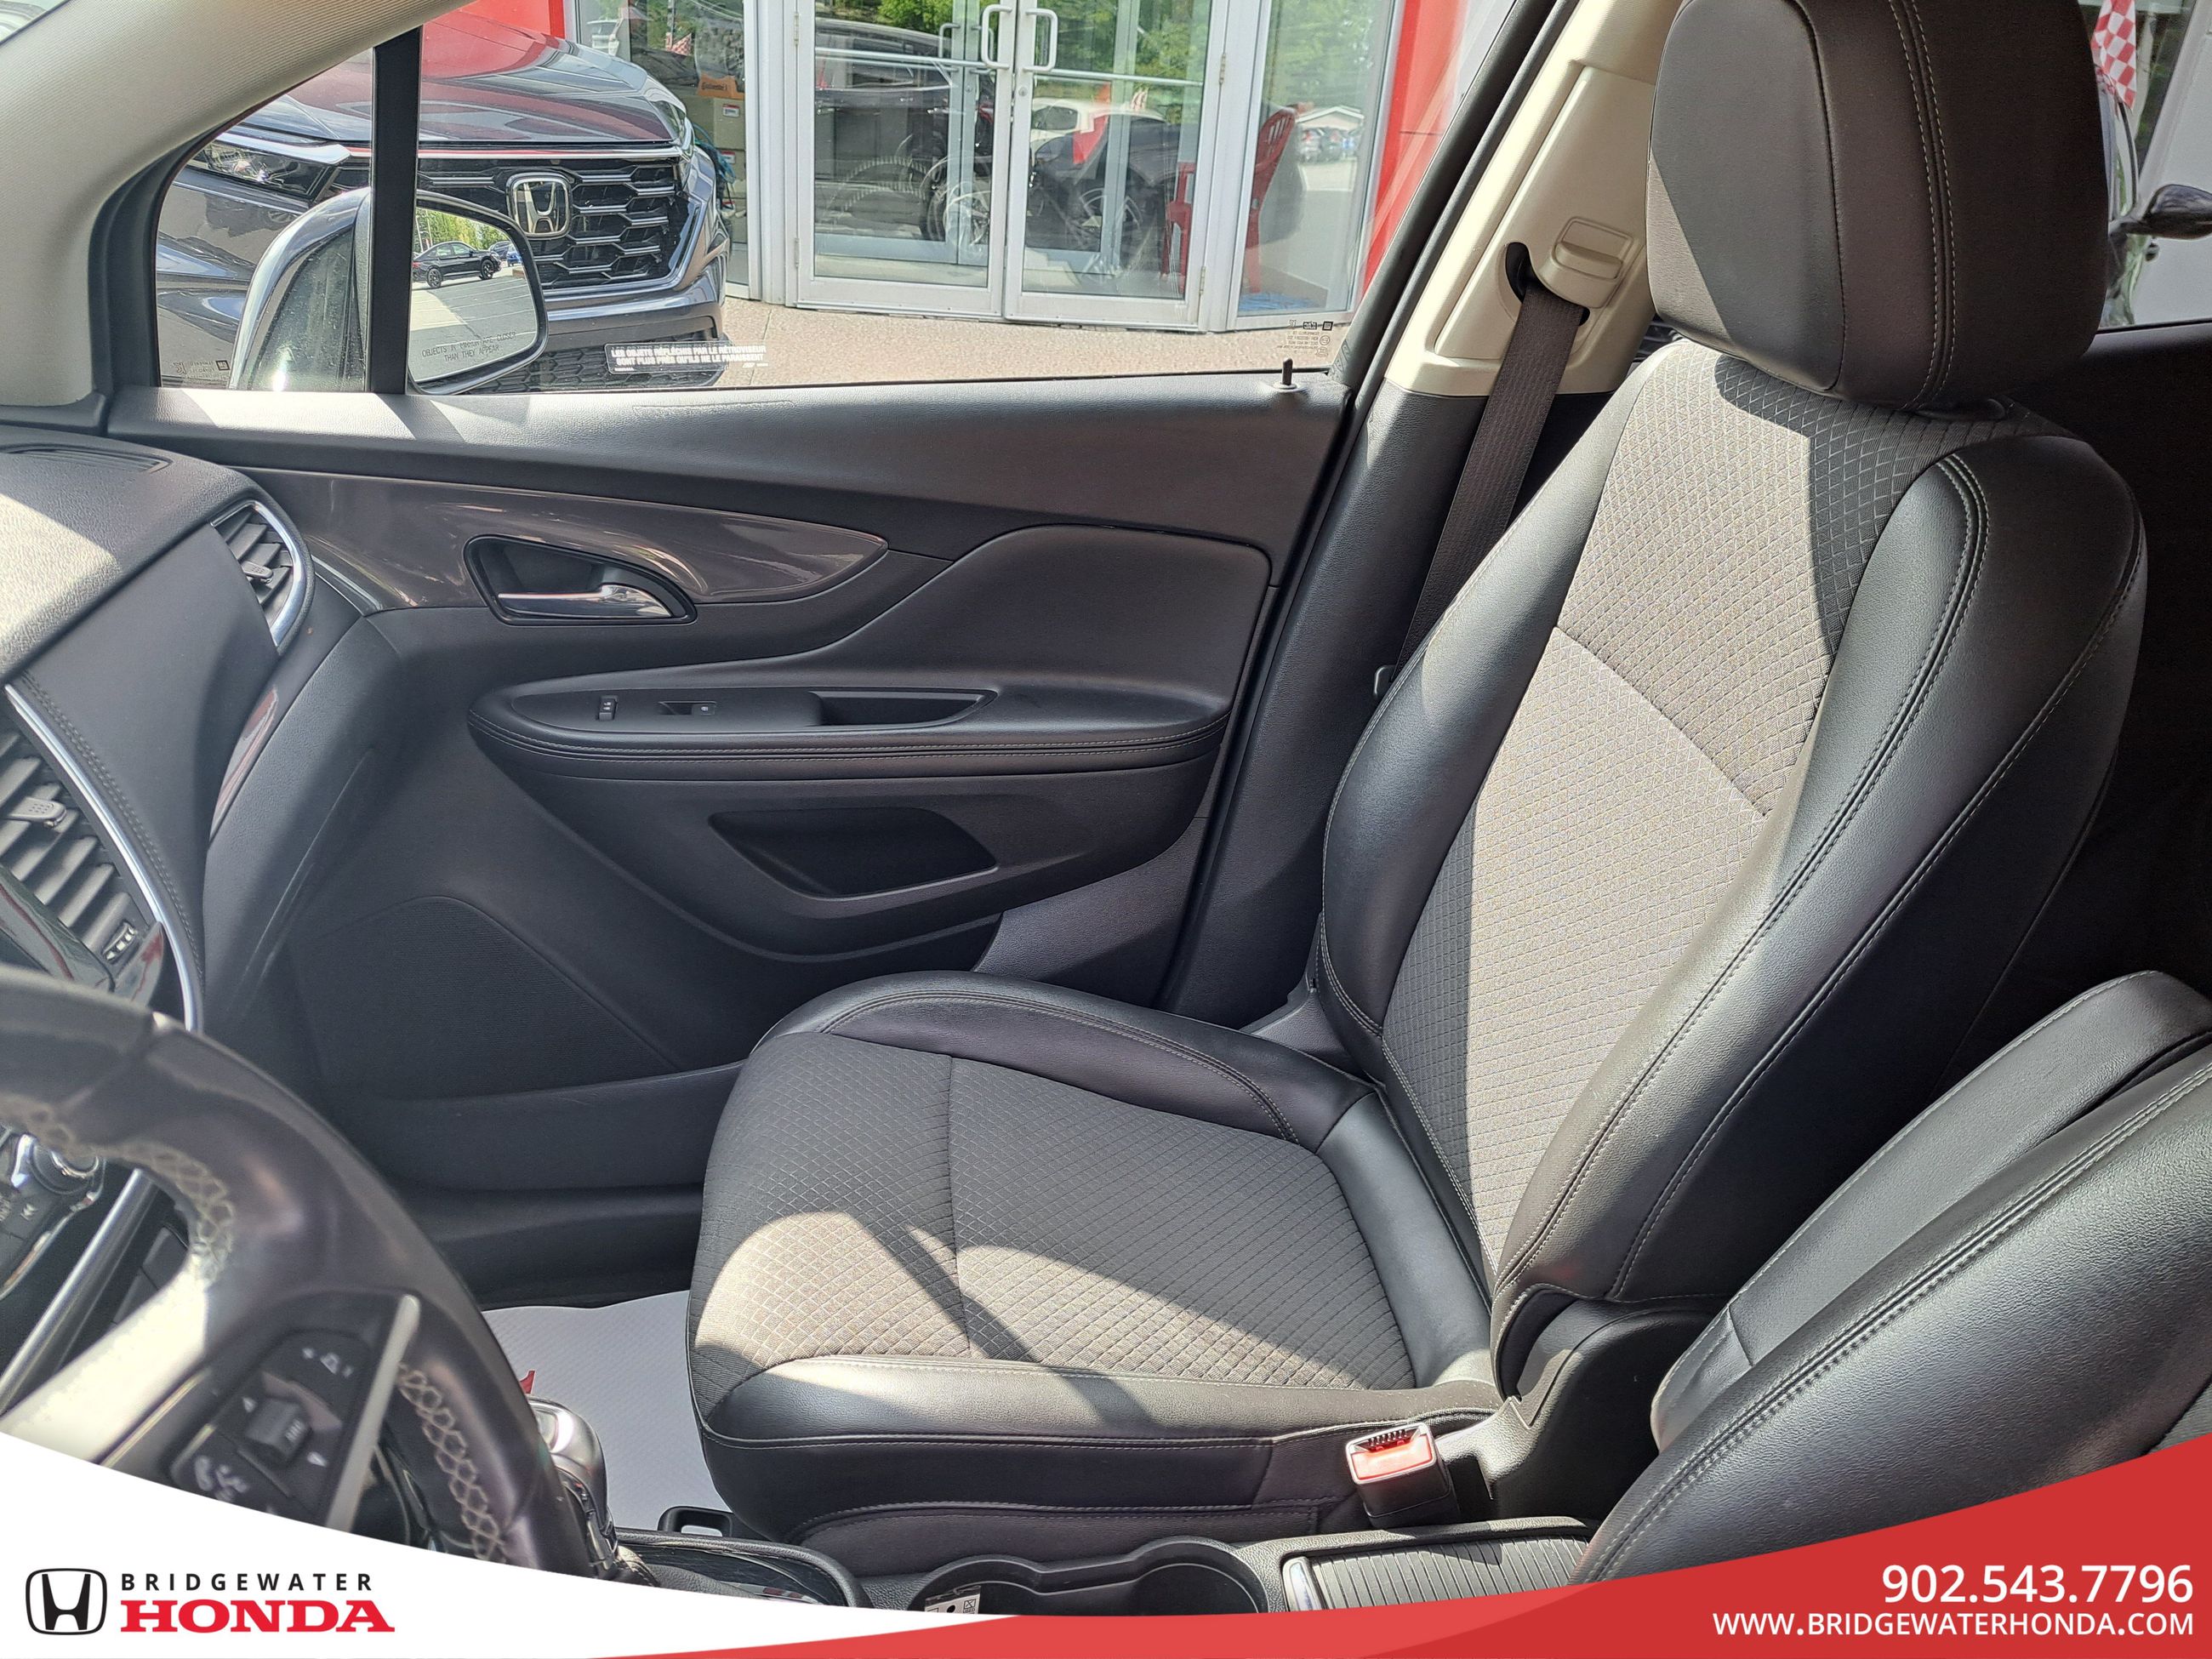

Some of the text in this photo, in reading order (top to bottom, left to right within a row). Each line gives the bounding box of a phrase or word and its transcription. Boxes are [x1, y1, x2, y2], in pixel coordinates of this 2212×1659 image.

[421, 346, 448, 357] OBJECTS
[497, 331, 516, 342] CLOSER
[444, 345, 499, 362] THAN THEY APPEAR
[611, 348, 626, 357] LES
[626, 347, 653, 357] OBJETS
[693, 346, 708, 355] PAR
[709, 346, 718, 355] LE
[616, 356, 637, 366] SONT
[637, 356, 656, 365] PLUS
